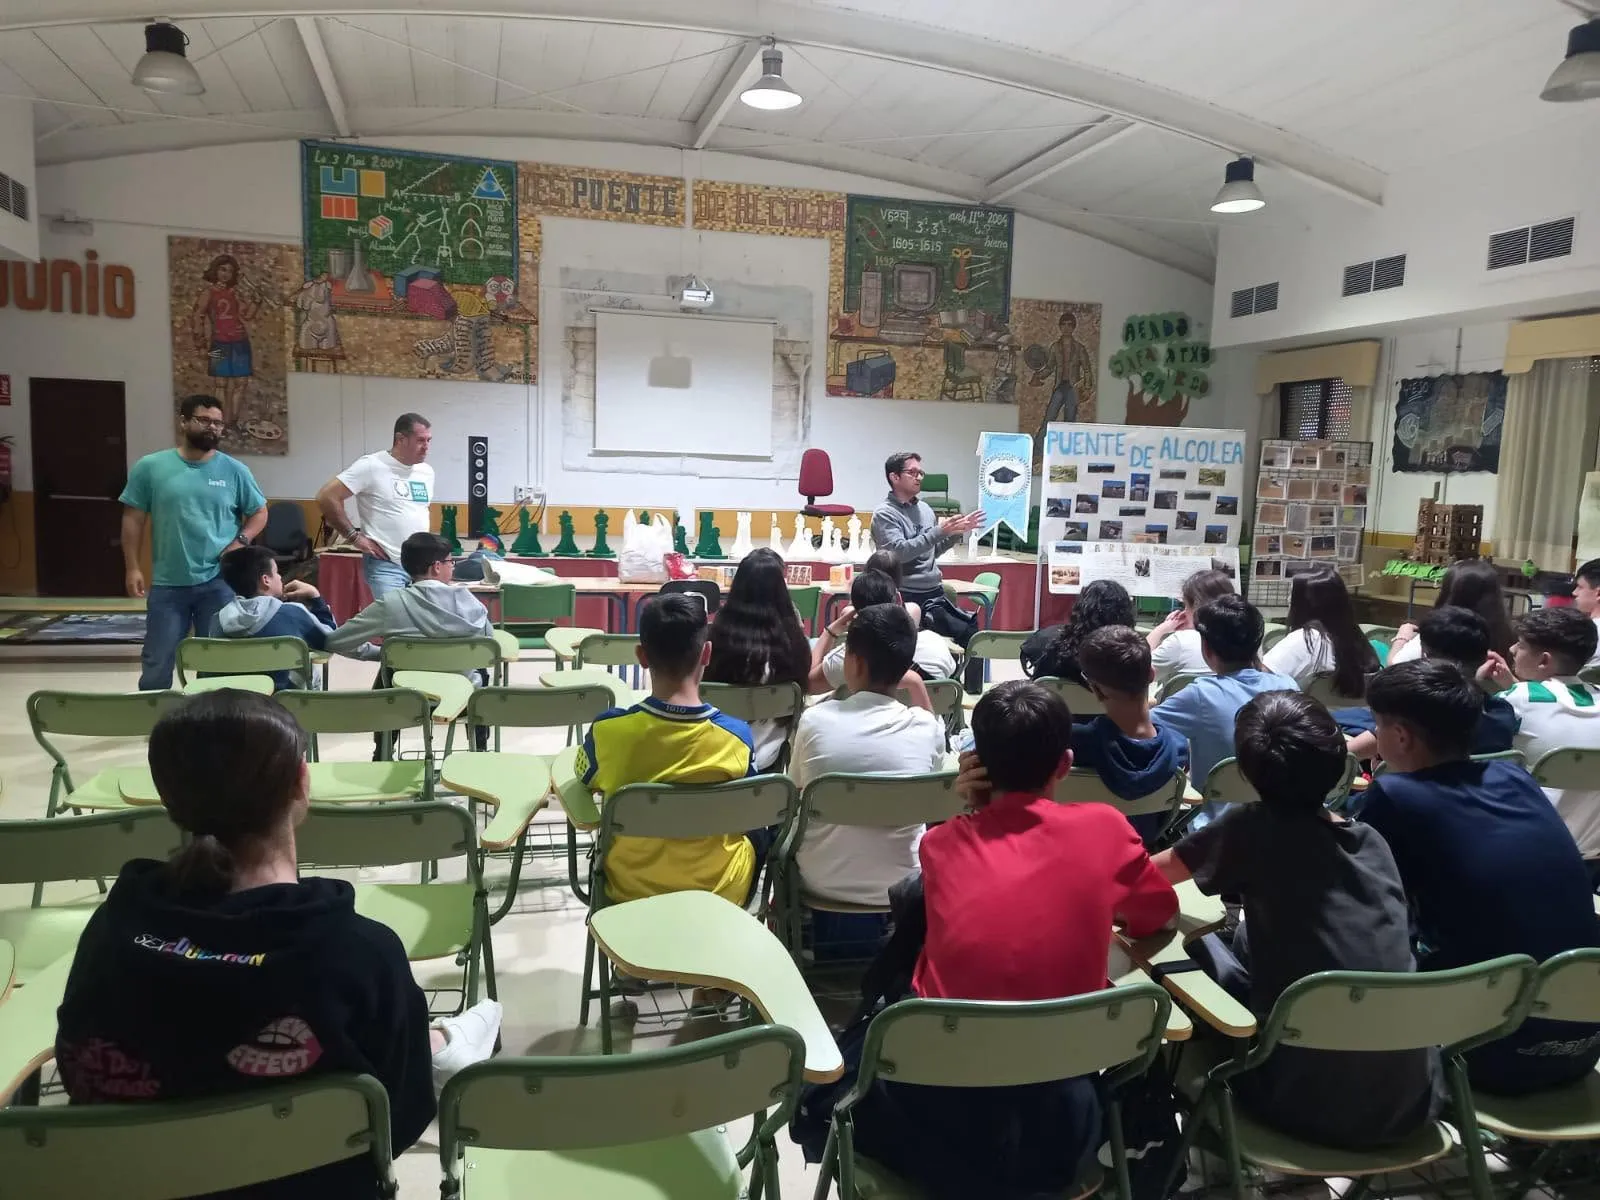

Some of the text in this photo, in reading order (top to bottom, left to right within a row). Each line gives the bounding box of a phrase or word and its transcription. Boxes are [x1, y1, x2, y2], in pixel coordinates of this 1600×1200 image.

[571, 177, 678, 217] PUENTE
[694, 189, 728, 222] DE
[217, 299, 233, 320] 2
[1046, 431, 1244, 469] PUENTE DE ALCOLEA
[228, 1046, 312, 1074] EFFECT
